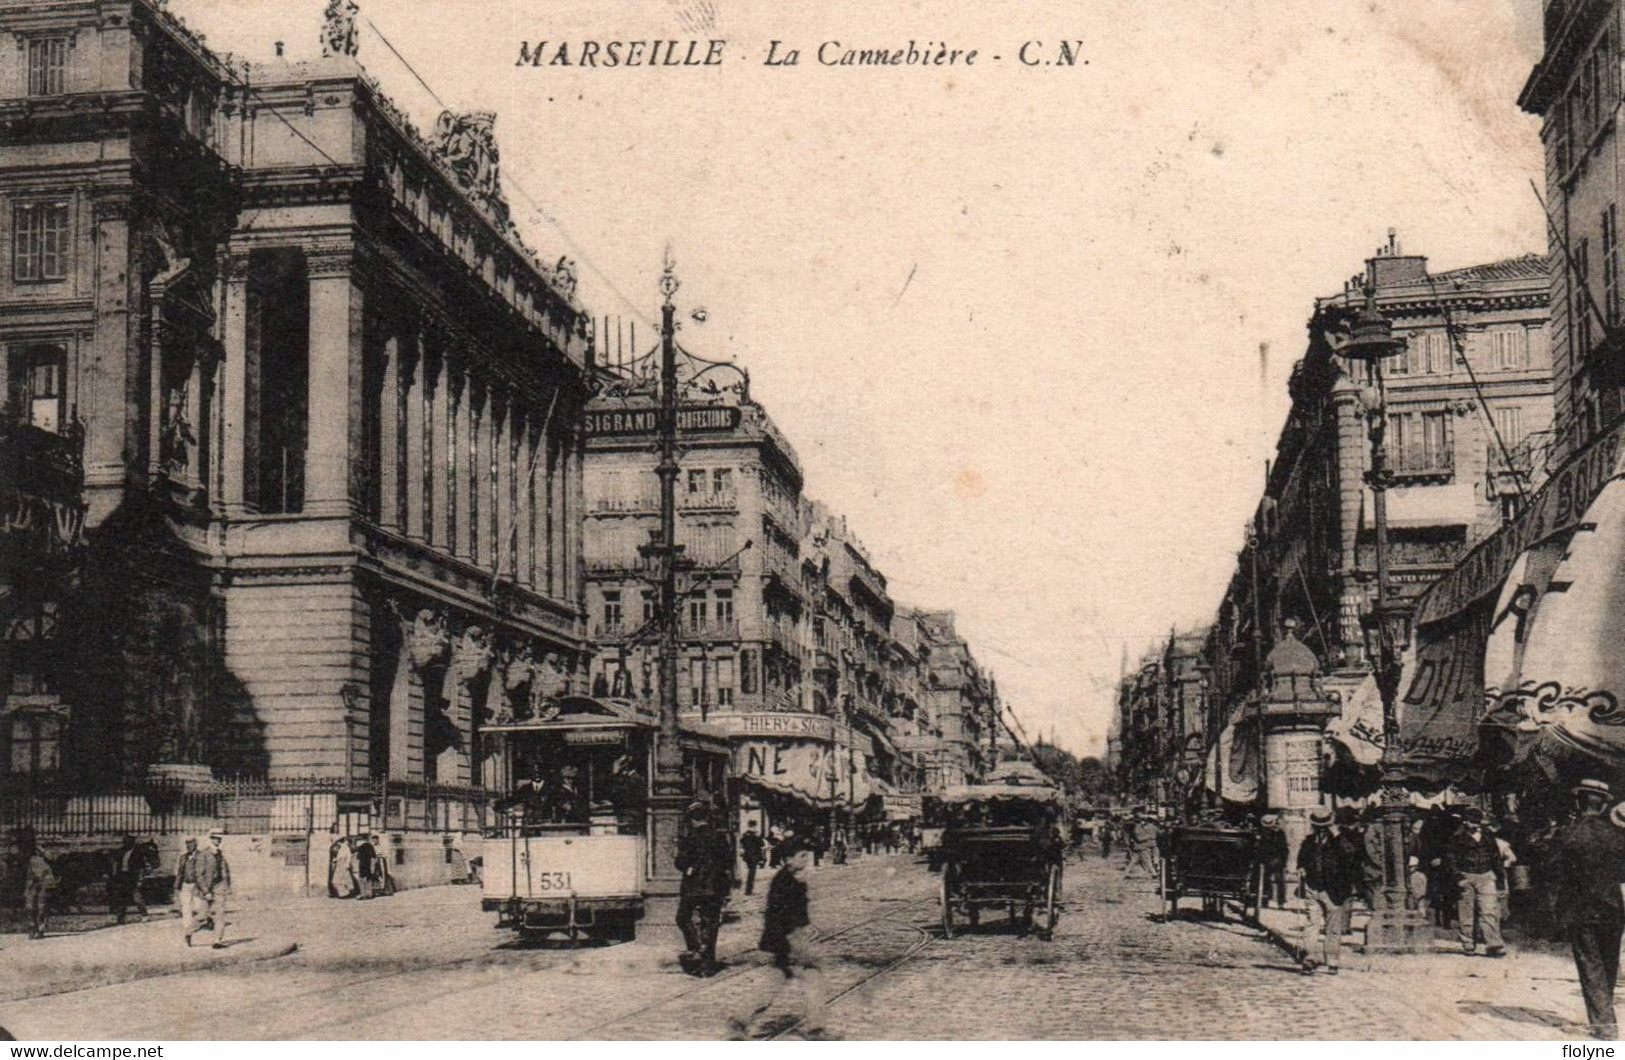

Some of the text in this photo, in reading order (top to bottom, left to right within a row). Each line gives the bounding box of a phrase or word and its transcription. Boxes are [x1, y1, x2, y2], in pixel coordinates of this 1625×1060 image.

[584, 412, 656, 433] SIGRAND
[742, 717, 790, 732] THIERY
[540, 871, 572, 891] 531
